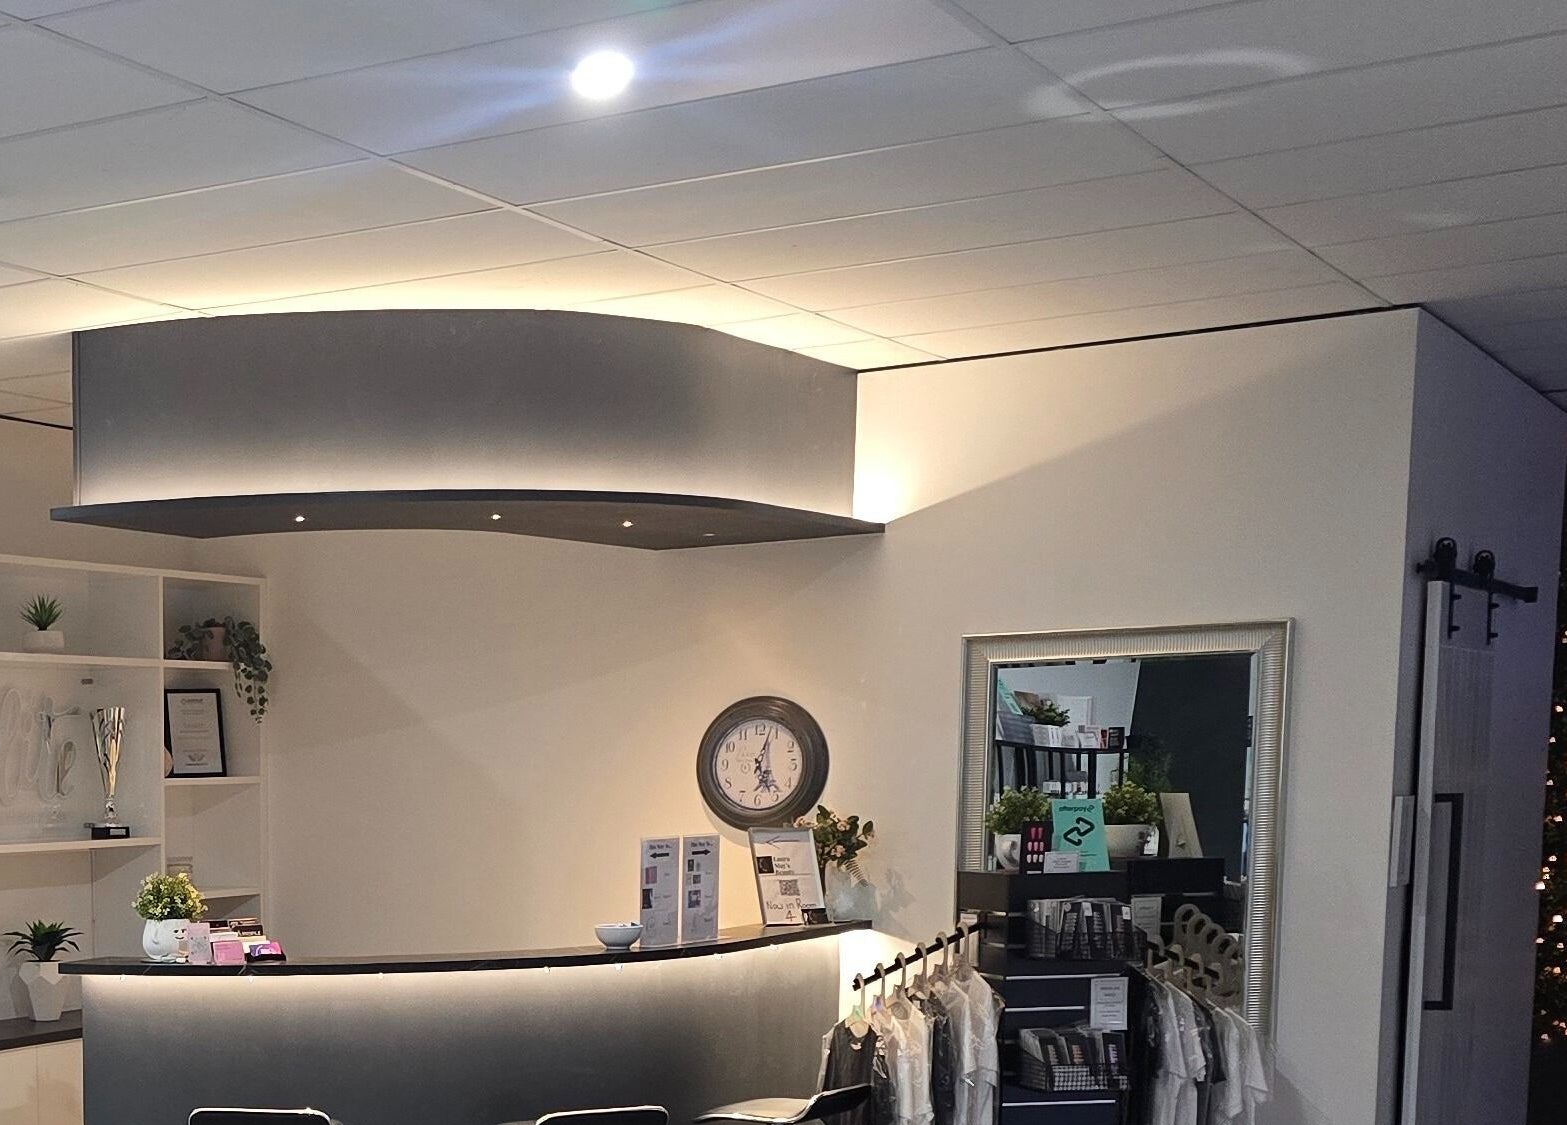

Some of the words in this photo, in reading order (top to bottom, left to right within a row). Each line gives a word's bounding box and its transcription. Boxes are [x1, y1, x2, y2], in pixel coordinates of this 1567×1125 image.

[739, 729, 748, 741] 11
[755, 724, 766, 736] 12
[725, 741, 735, 753] 10
[721, 759, 729, 771] 9
[754, 794, 762, 807] 6
[766, 900, 783, 910] Now
[795, 898, 817, 909] Room
[785, 910, 797, 922] 4
